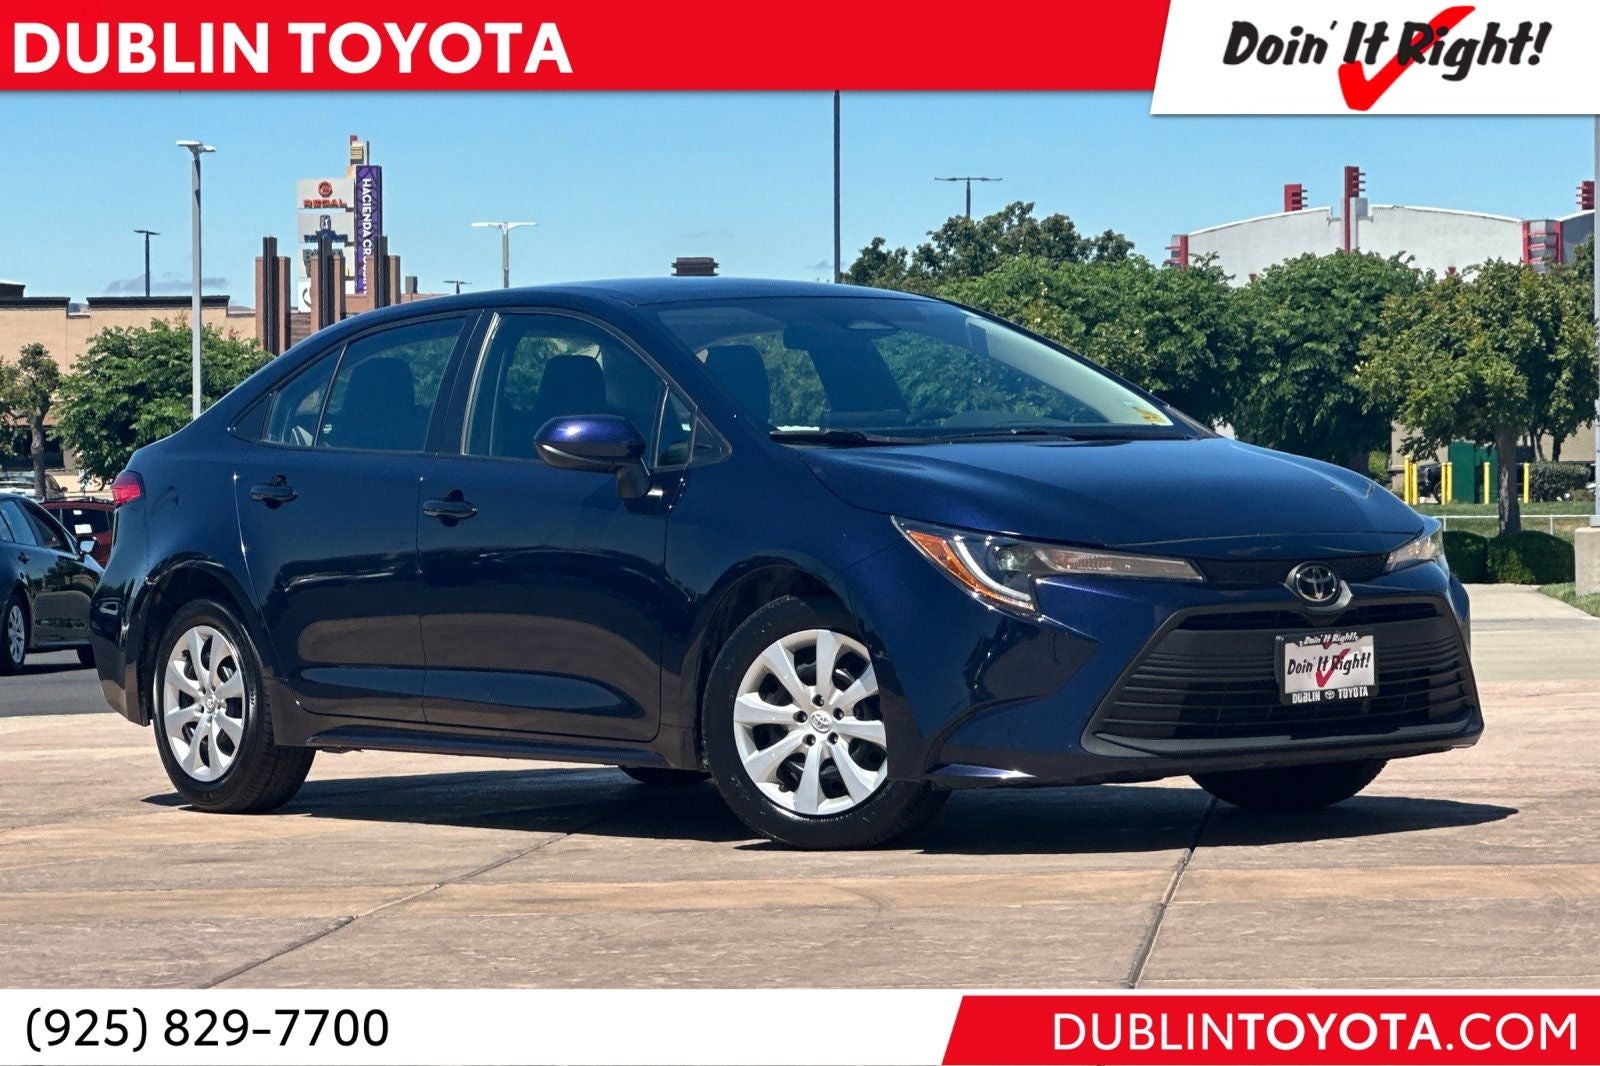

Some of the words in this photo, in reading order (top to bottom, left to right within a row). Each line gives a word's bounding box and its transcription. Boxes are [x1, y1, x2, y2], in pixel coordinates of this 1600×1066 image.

[361, 178, 372, 237] HACIENDA
[1287, 657, 1316, 675] Doin'
[1317, 655, 1329, 672] It
[1331, 652, 1371, 675] Right!
[1292, 690, 1321, 704] DUBLIN
[1338, 686, 1369, 700] TOYOTA
